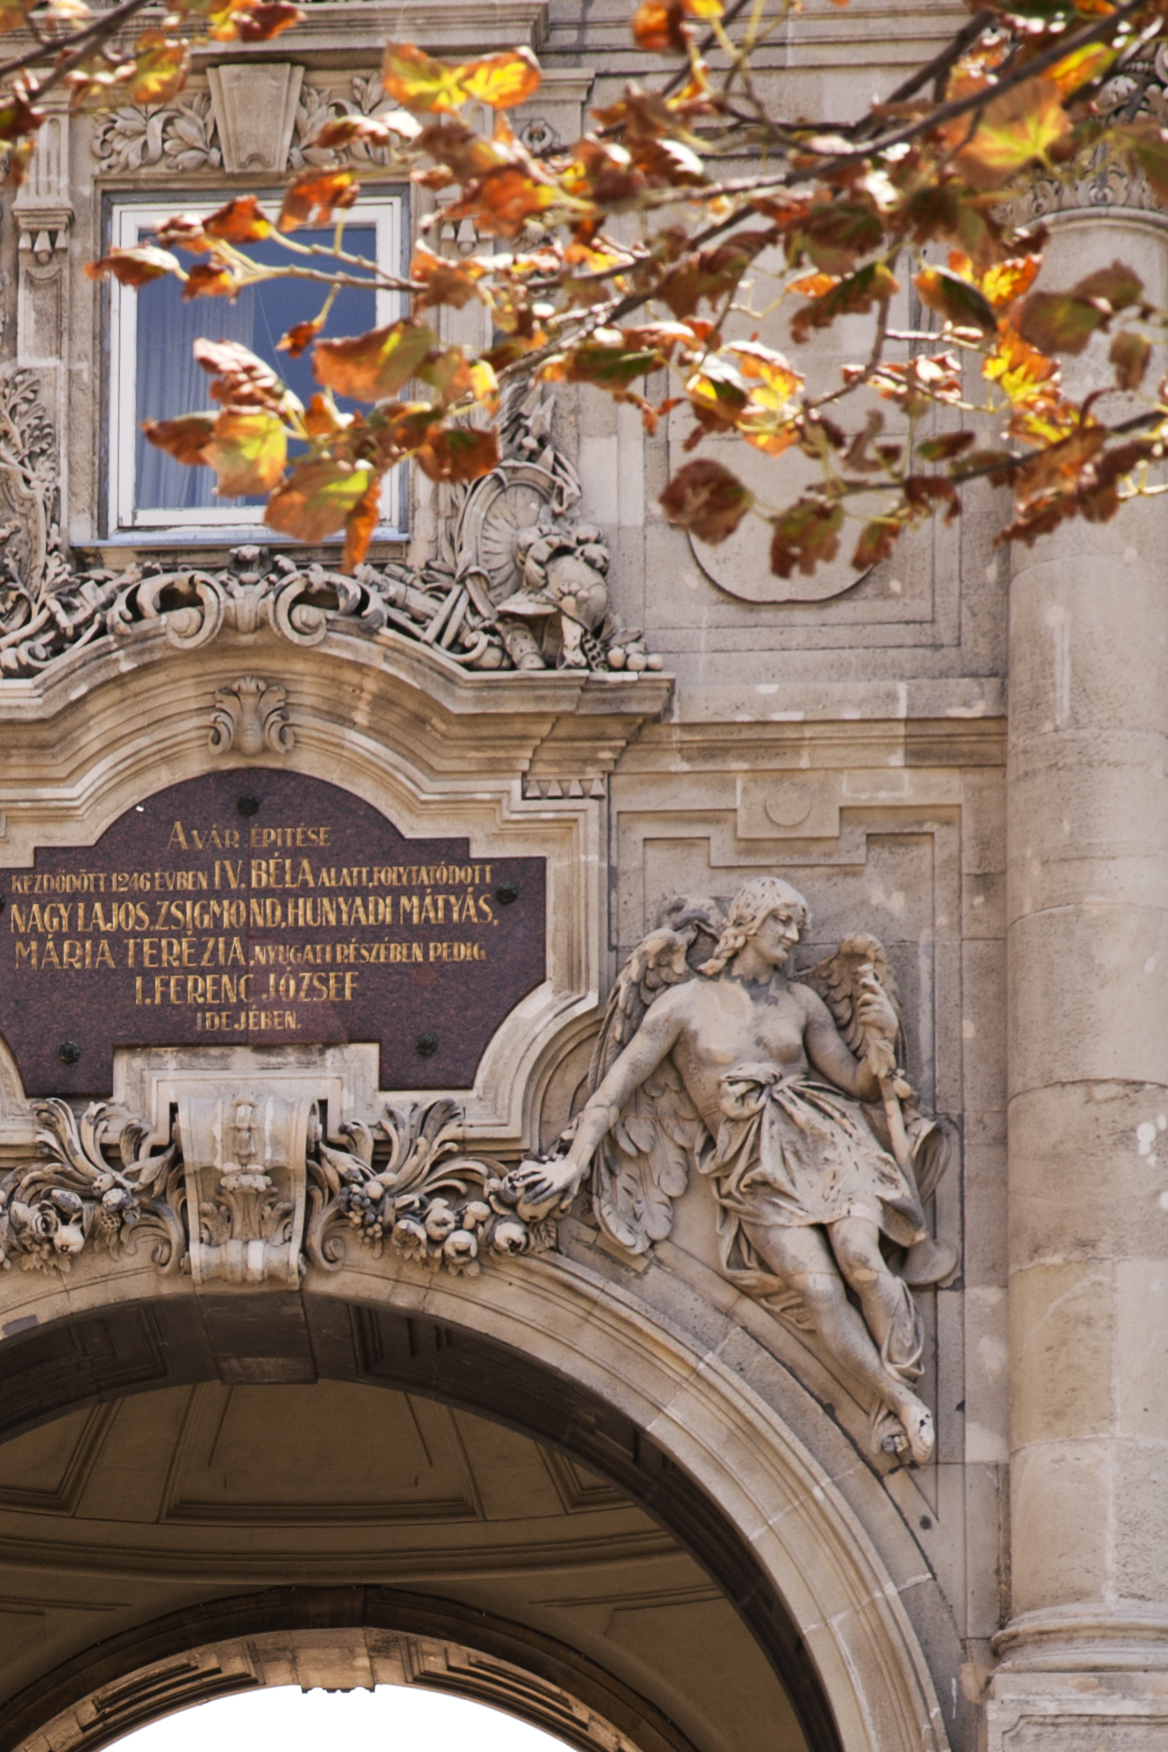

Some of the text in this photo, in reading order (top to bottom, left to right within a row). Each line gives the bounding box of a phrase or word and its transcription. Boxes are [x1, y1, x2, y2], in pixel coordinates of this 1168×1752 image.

[166, 820, 189, 850] A
[190, 823, 241, 850] VÁR
[111, 872, 152, 893] 1246
[154, 867, 209, 892] ÉVBEN
[213, 859, 247, 891] IV.
[250, 851, 316, 889] BÉLA
[373, 860, 494, 887] FOLYTATÓDOTT
[10, 902, 74, 934] NAGY
[155, 897, 287, 930] ZSIGMOND,
[287, 895, 393, 928] HUNYADI
[399, 886, 500, 927] MÁTYÁS,
[14, 930, 488, 970] MÁRIA TERÉZIA, NYUGATI RÉSZÉBEN PEDIG
[153, 973, 254, 1005] FERENC
[261, 966, 360, 1003] JÓZSEF
